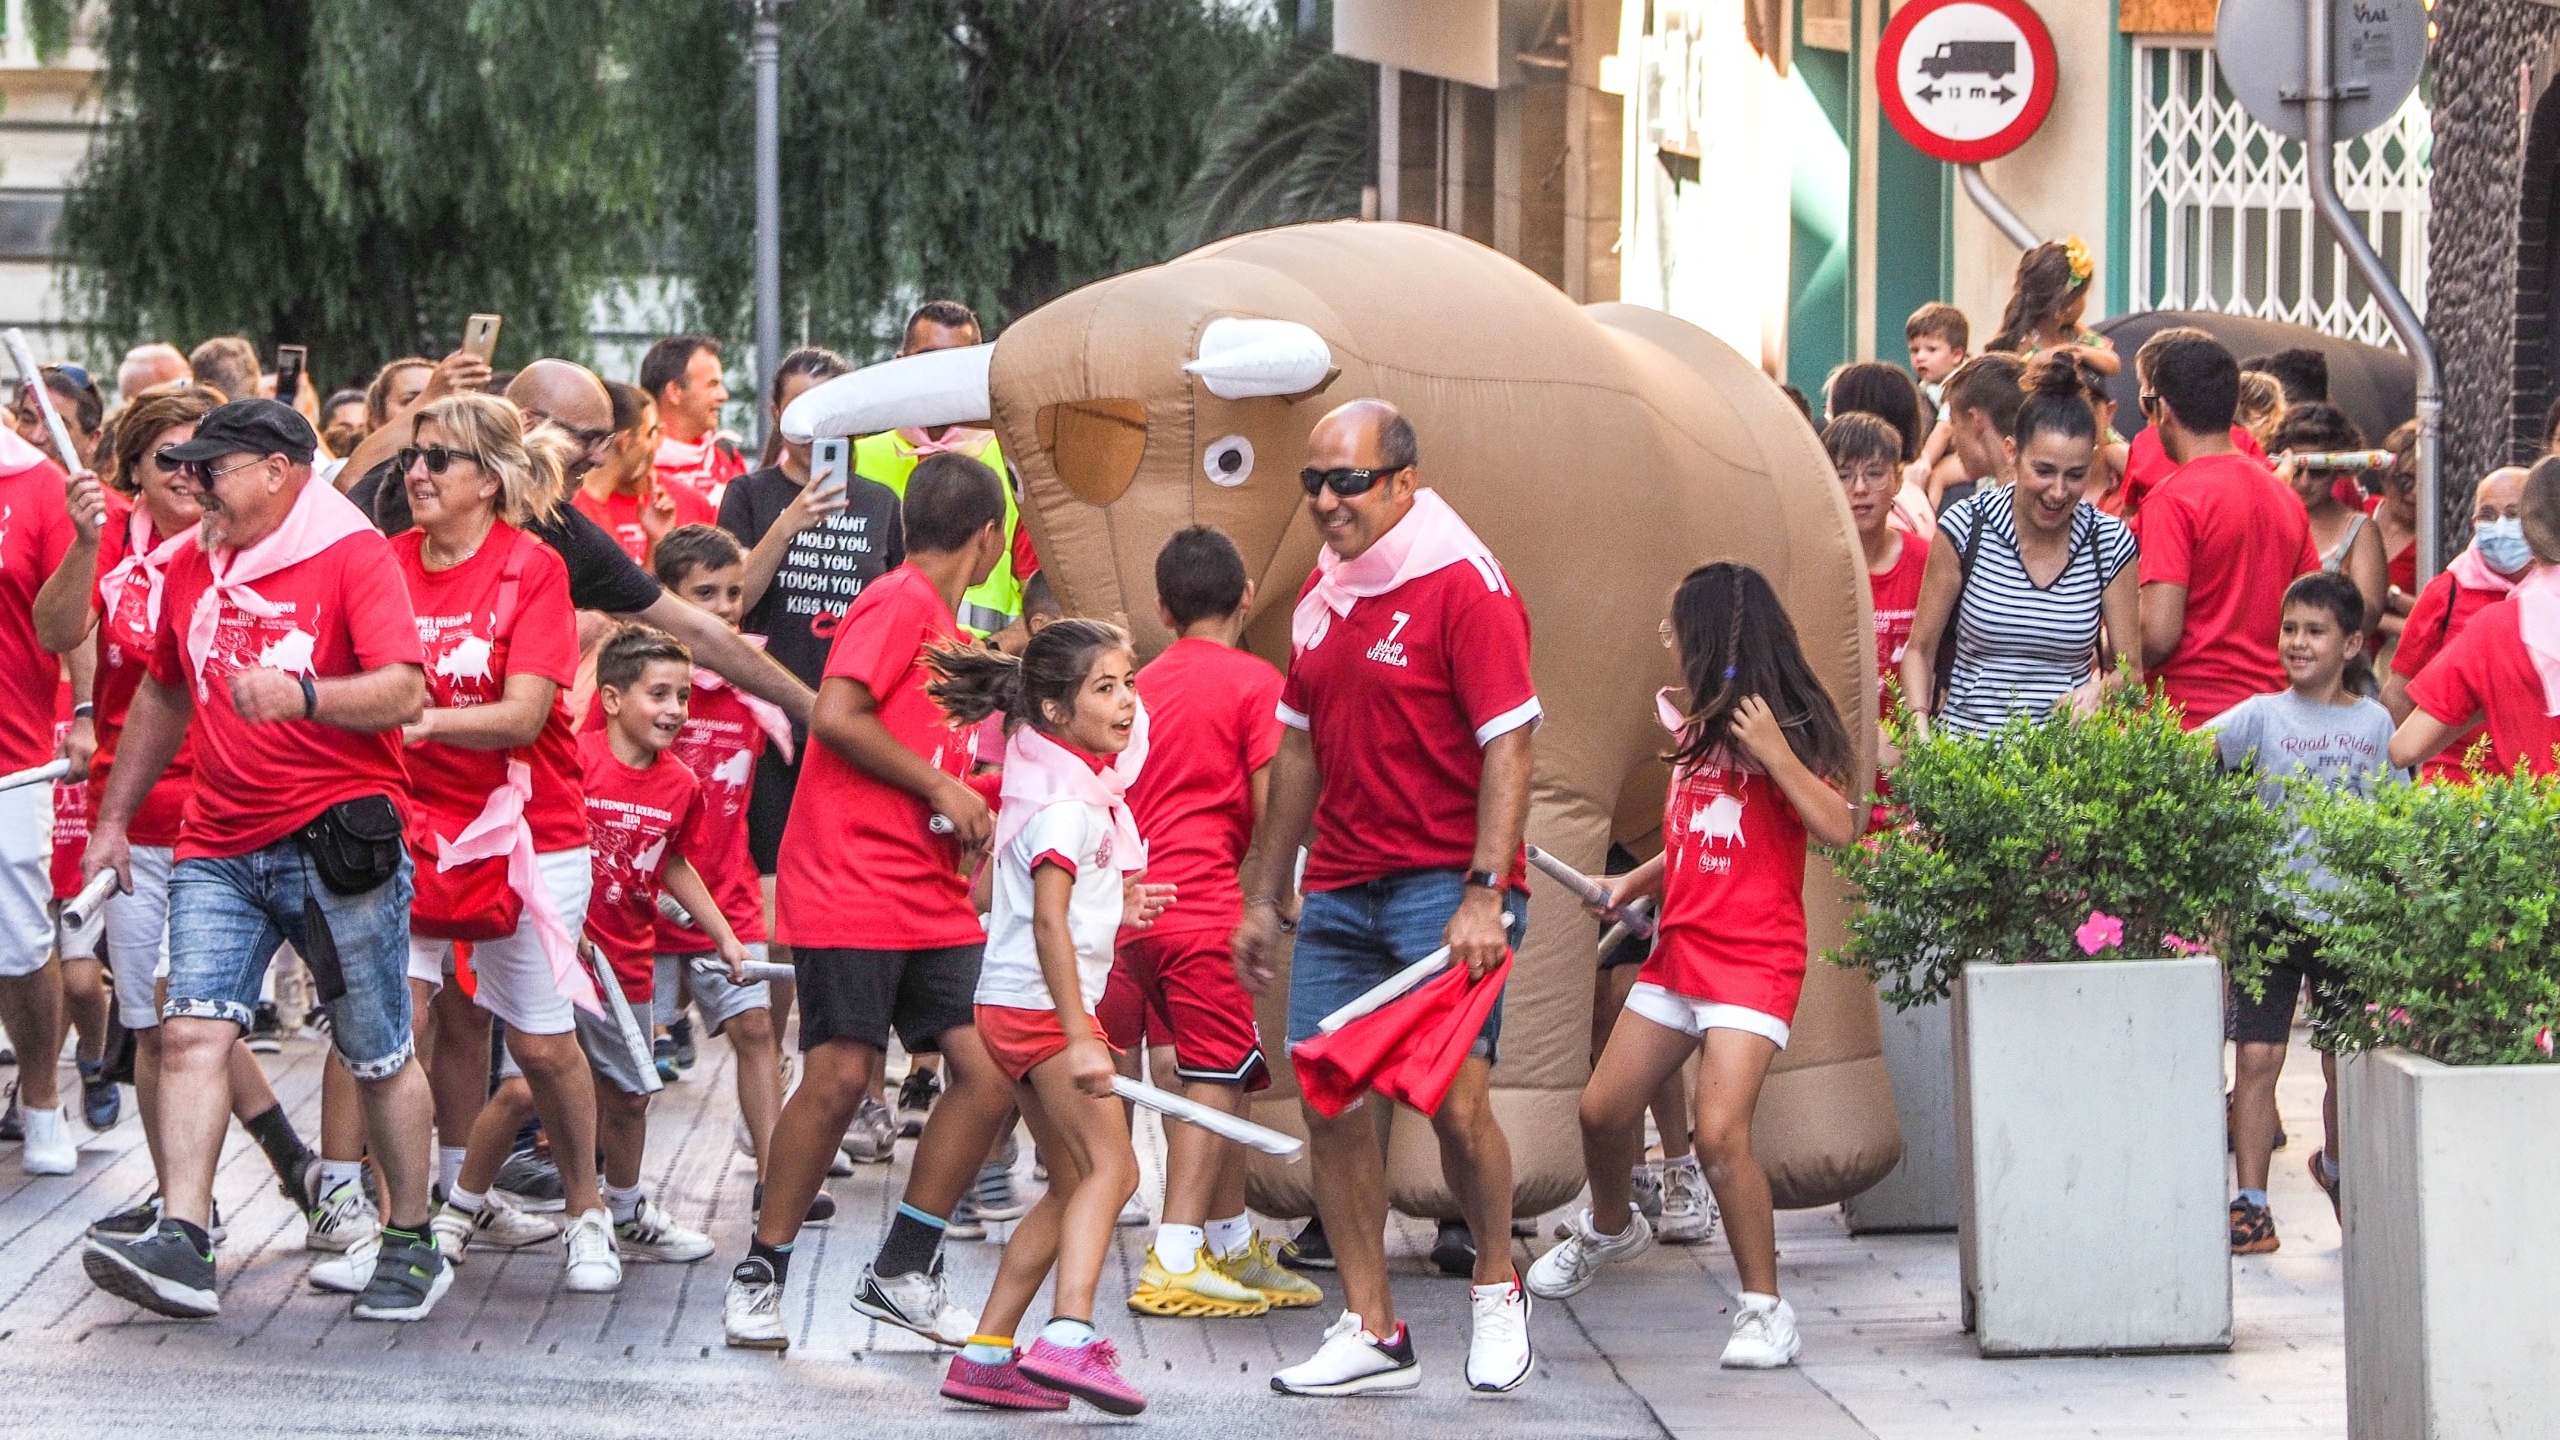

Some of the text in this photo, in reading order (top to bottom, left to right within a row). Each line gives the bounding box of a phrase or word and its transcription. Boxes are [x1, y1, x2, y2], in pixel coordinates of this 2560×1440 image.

[1948, 86, 1986, 98] 13 m
[826, 514, 867, 532] WANT
[796, 531, 872, 553] HOLD YOU,
[788, 550, 857, 572] HUG YOU,
[777, 571, 829, 593] TOUCH
[787, 595, 821, 615] KISS
[1387, 610, 1411, 642] 7
[1375, 638, 1404, 655] JULIO
[2281, 735, 2330, 757] Road
